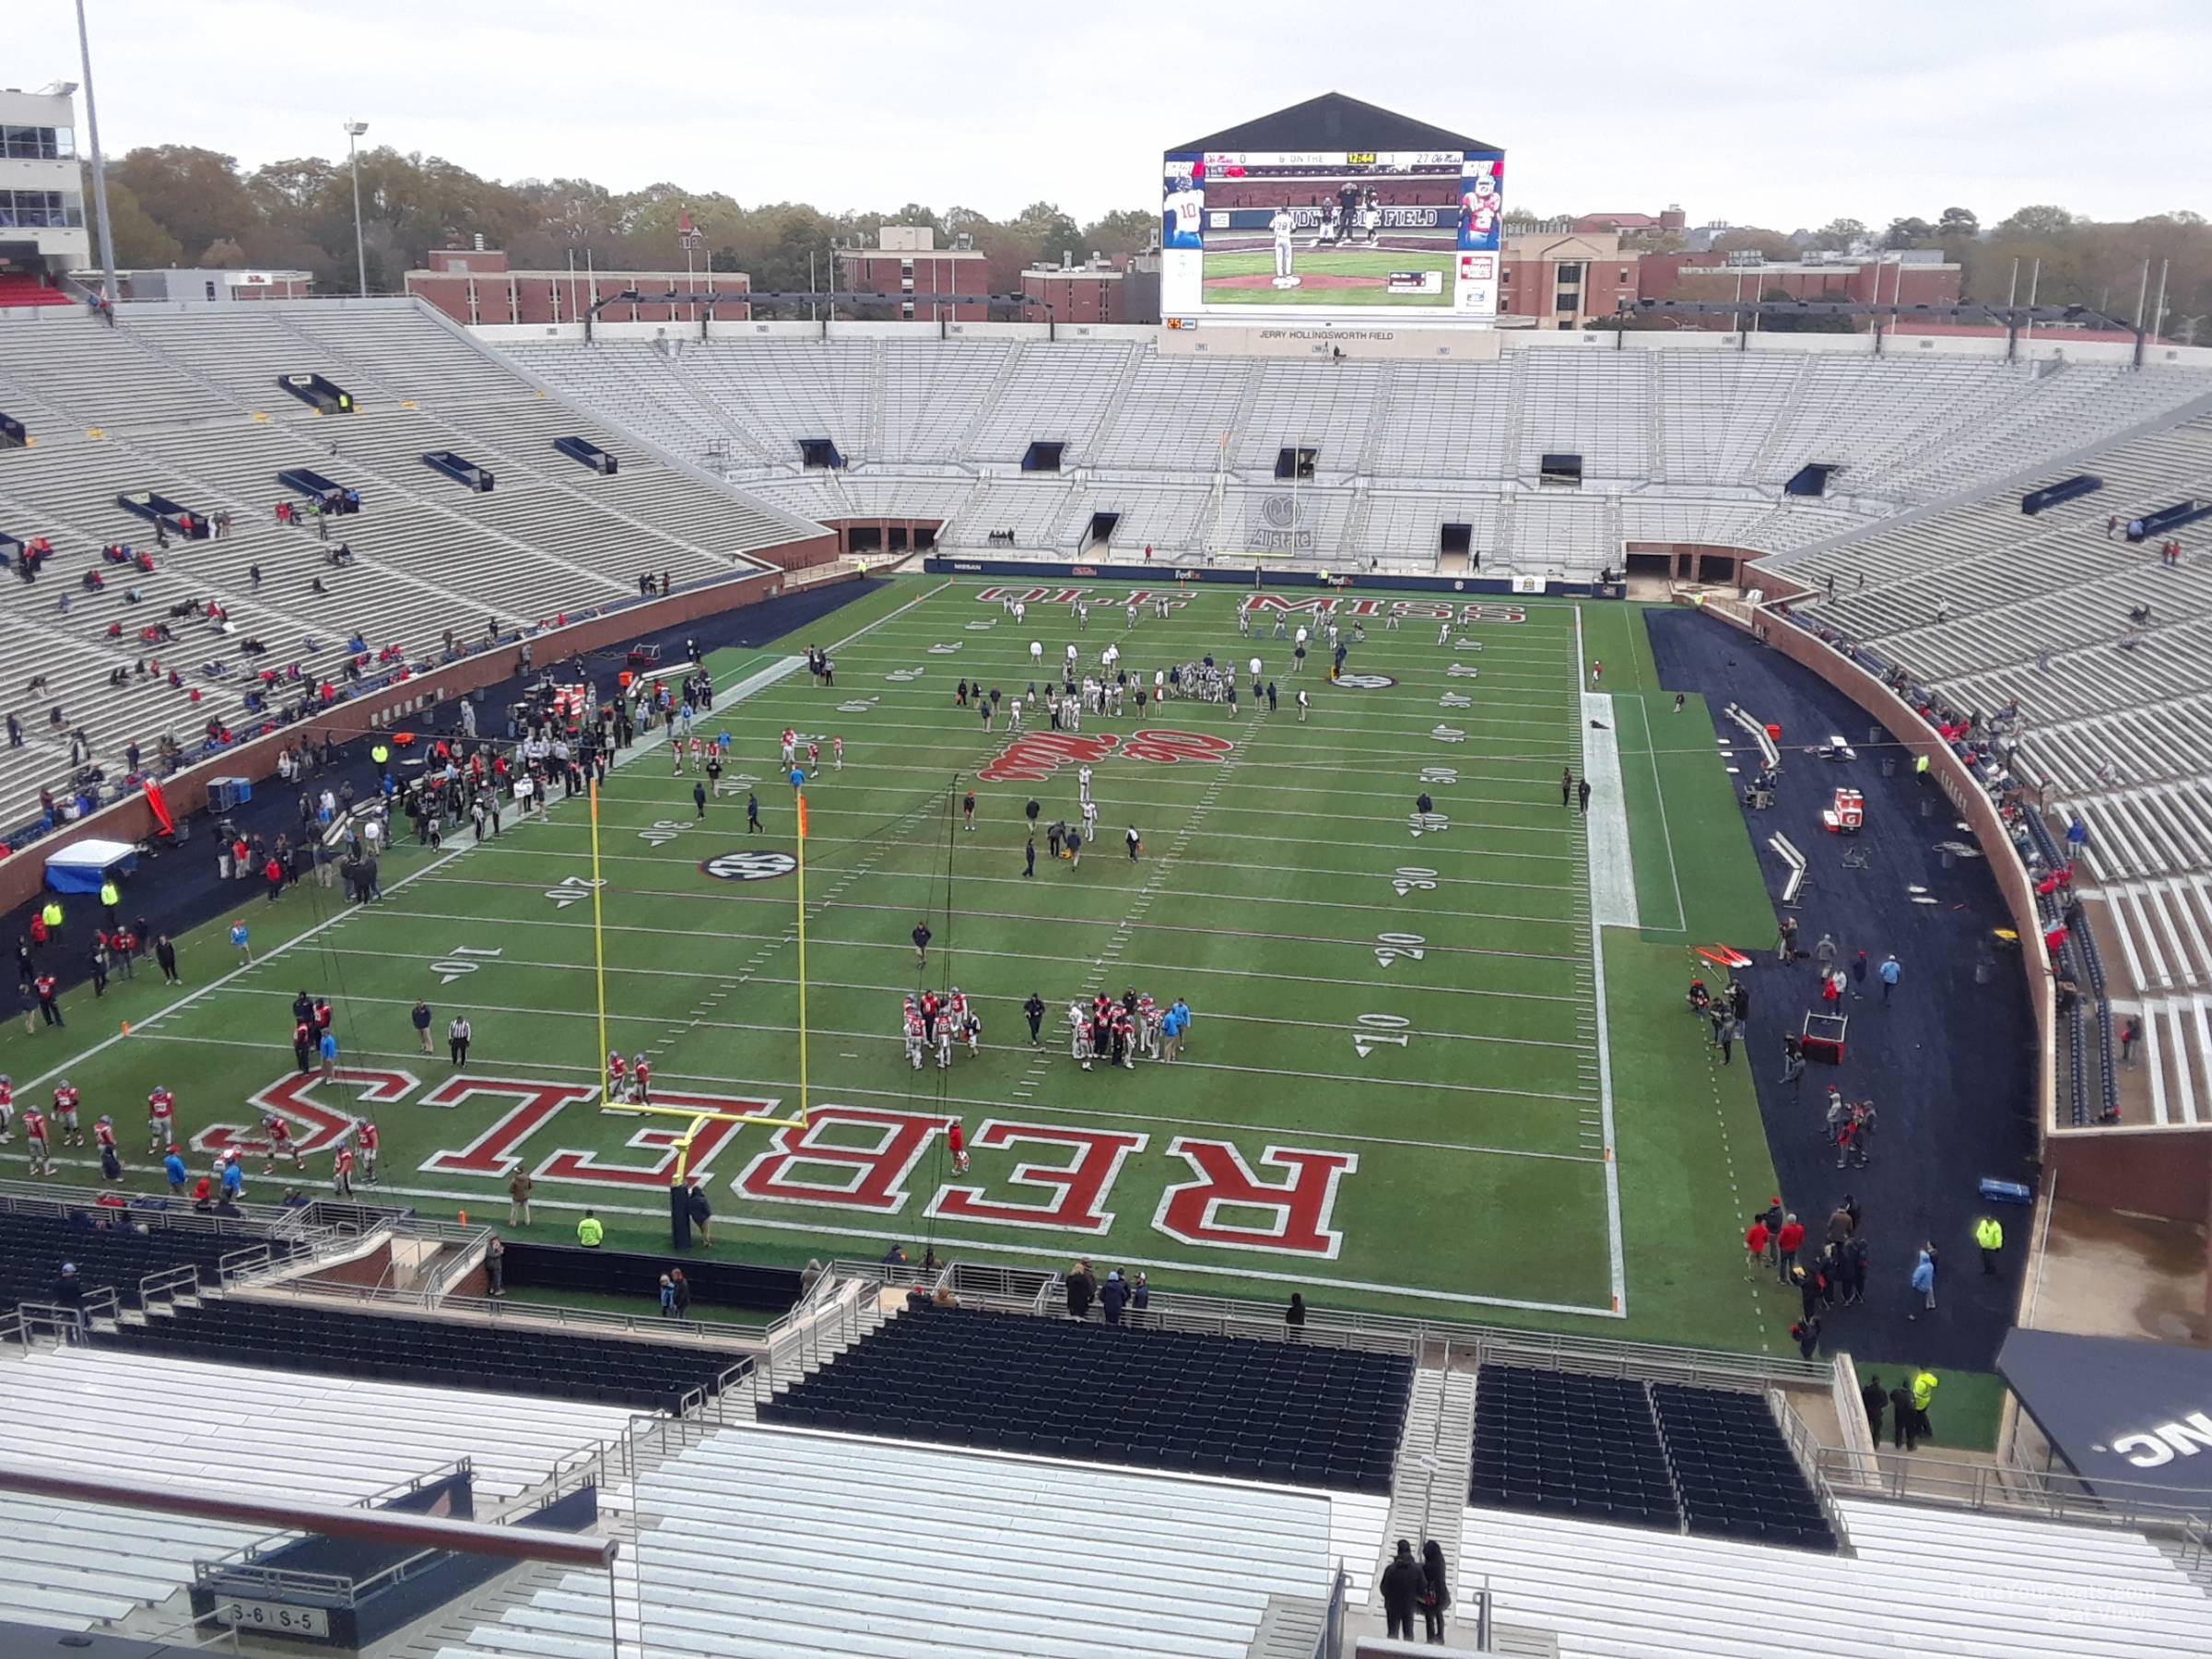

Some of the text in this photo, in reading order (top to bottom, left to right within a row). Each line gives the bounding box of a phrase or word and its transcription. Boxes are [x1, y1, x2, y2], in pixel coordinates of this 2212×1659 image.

[1240, 154, 1246, 164] 0
[1181, 203, 1196, 218] 10
[1384, 209, 1437, 226] FIELD
[1289, 331, 1367, 340] HOLLINGSWORTH
[1369, 332, 1394, 340] FIELD
[1253, 530, 1310, 547] Allstate
[1175, 571, 1203, 580] FedEx
[1328, 576, 1355, 585] FedEx
[975, 585, 1527, 624] OLE MISS
[978, 729, 1234, 782] Ole Miss
[1419, 768, 1458, 783] 50
[638, 819, 694, 842] 30
[708, 852, 798, 879] SEC
[544, 876, 608, 901] 20
[1392, 867, 1438, 889] 30
[1374, 933, 1426, 960] 20
[429, 946, 503, 974] 10
[1352, 1014, 1410, 1048] 10
[188, 1065, 1359, 1260] REBELS
[279, 1610, 312, 1630] S-5
